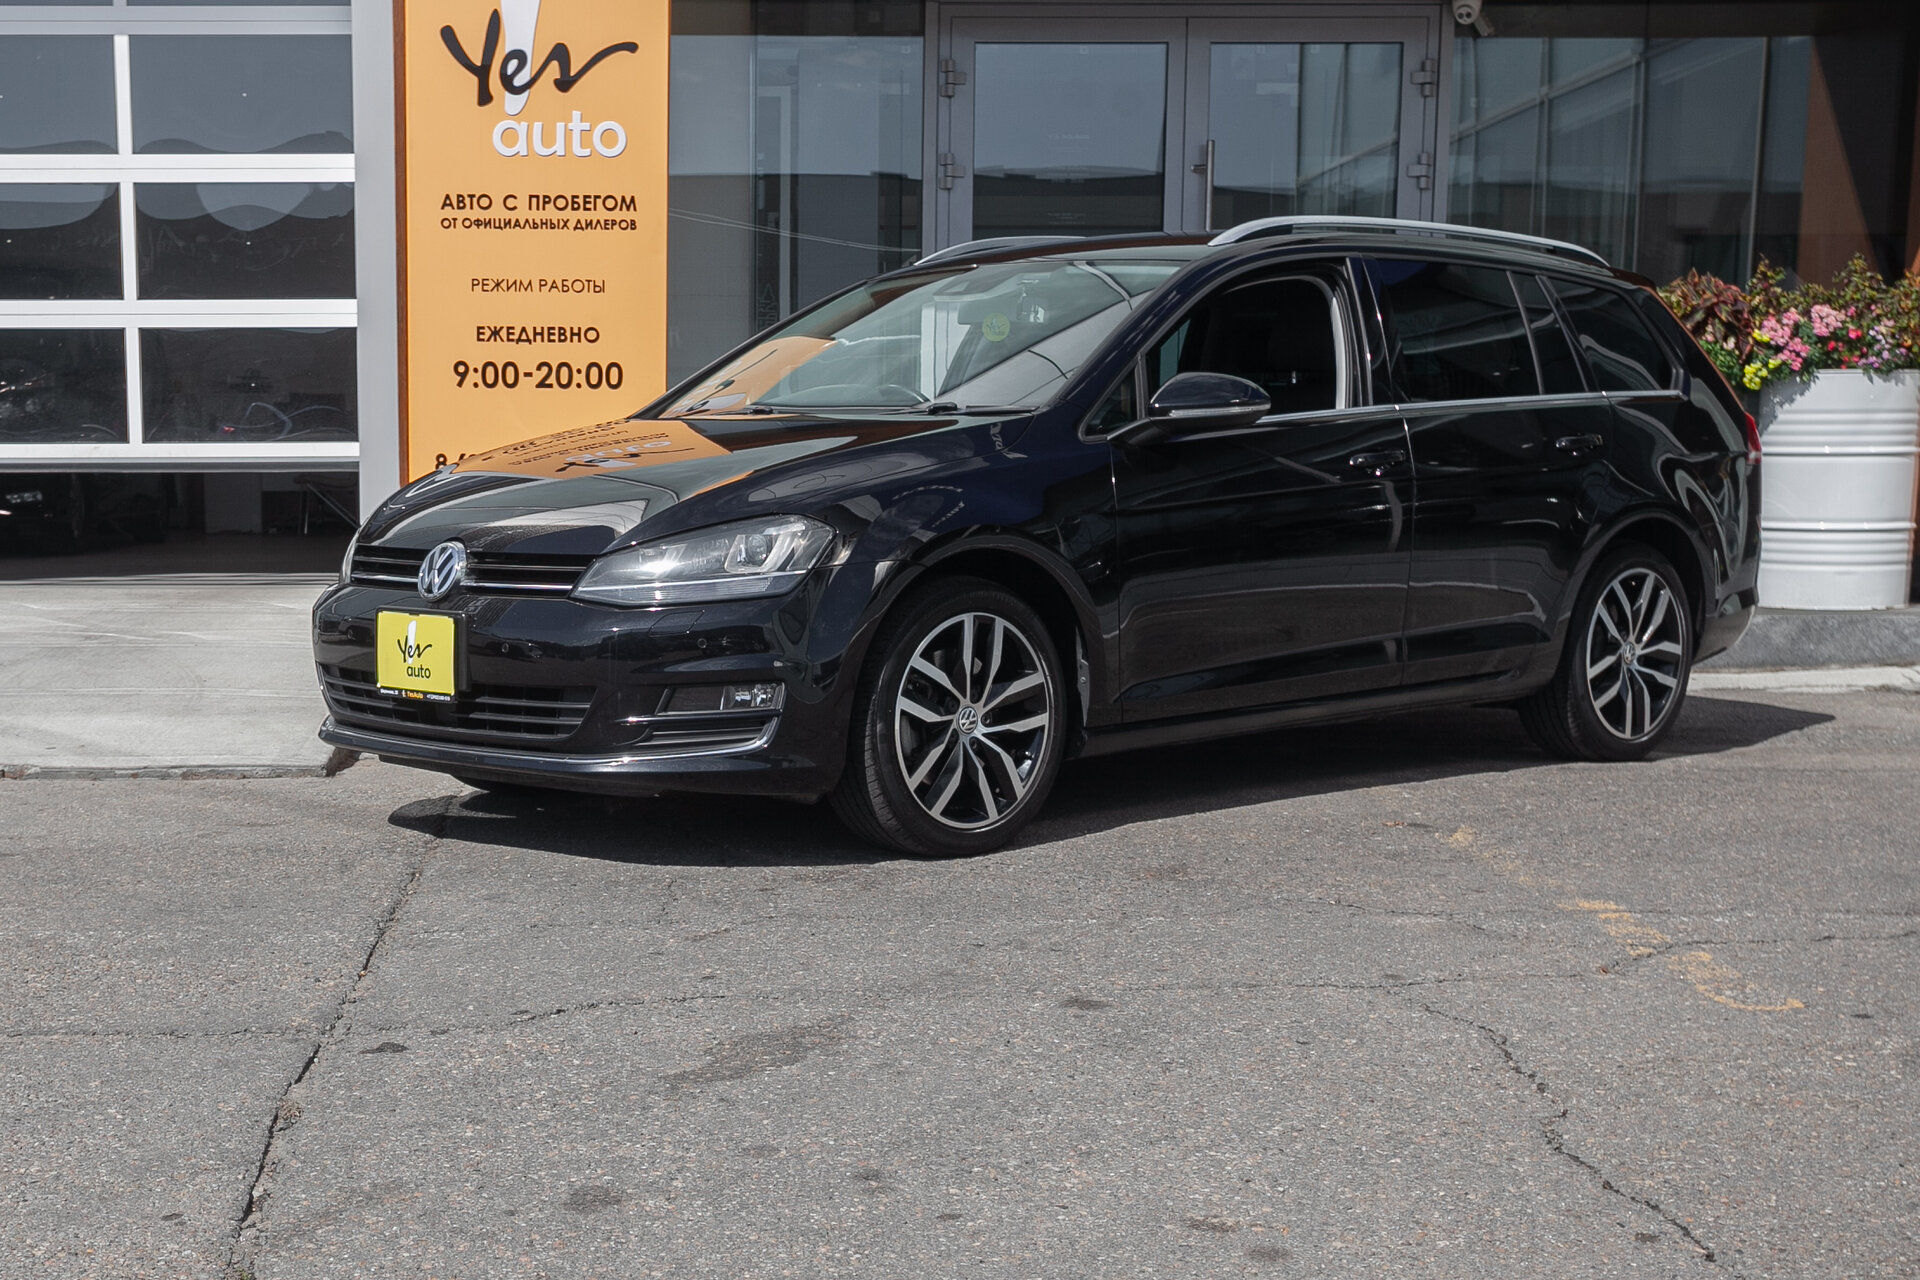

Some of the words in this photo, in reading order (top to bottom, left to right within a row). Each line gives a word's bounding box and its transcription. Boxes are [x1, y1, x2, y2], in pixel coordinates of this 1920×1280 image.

[492, 110, 628, 158] auto
[440, 193, 493, 211] АВТО
[502, 194, 518, 212] С
[528, 194, 637, 212] ПРОБЕГОМ
[440, 217, 458, 230] ОТ
[461, 217, 570, 231] ОФИЦИАЛЬНЫХ
[573, 218, 637, 232] ДИЛЕРОВ
[471, 278, 533, 293] РЕЖИМ
[538, 278, 605, 294] РАБОТЫ
[476, 325, 600, 345] ЕЖЕДНЕВНО
[453, 360, 624, 390] 9:00-20:00
[406, 664, 431, 679] auto
